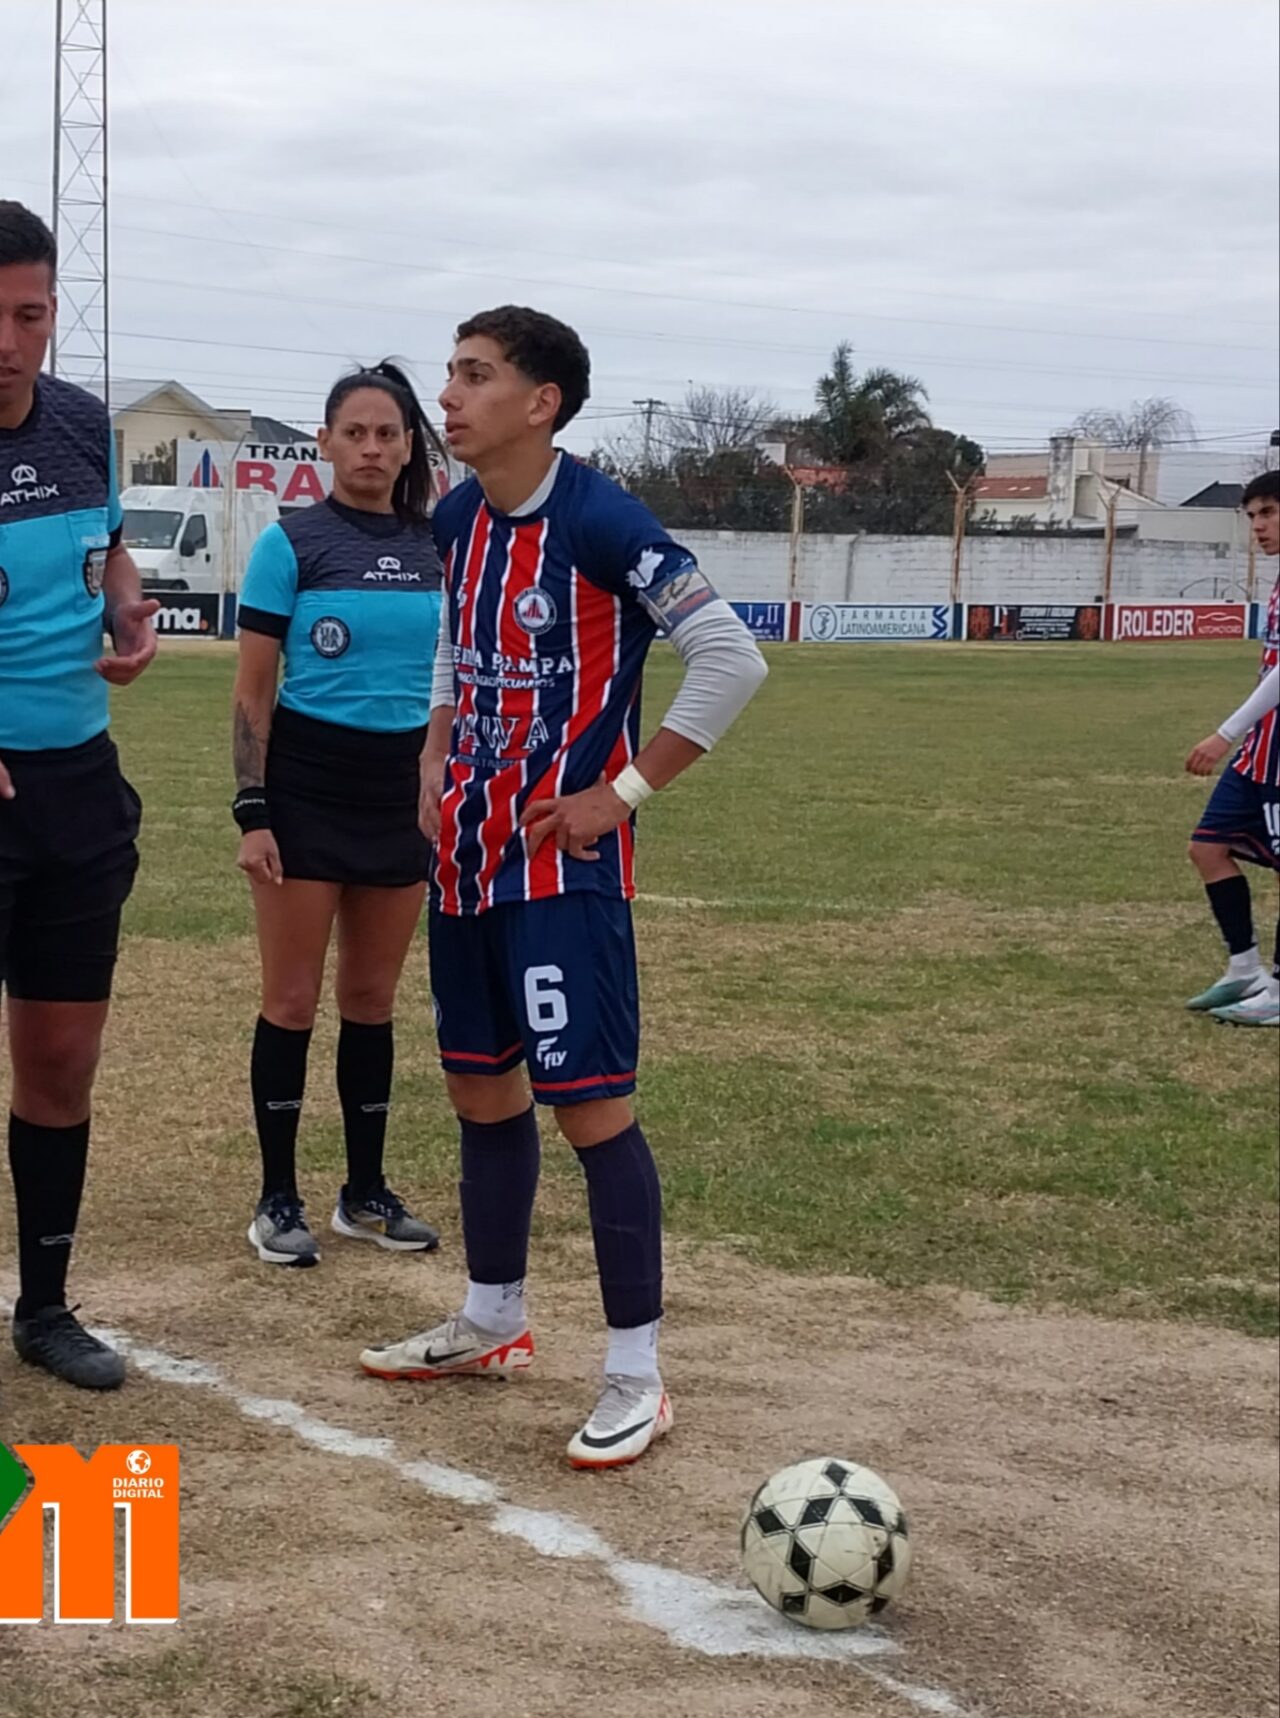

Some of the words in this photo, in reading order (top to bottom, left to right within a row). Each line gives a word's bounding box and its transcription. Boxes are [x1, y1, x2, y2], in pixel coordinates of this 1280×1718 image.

[245, 444, 326, 462] TRAN
[0, 483, 60, 507] ATHIX
[363, 570, 422, 583] ATHIX
[840, 611, 927, 620] FARMACIA
[1120, 609, 1195, 637] ROLEDER
[840, 623, 927, 635] LATINOAMERICANA
[491, 652, 575, 676] PAMPA
[524, 964, 569, 1032] 6
